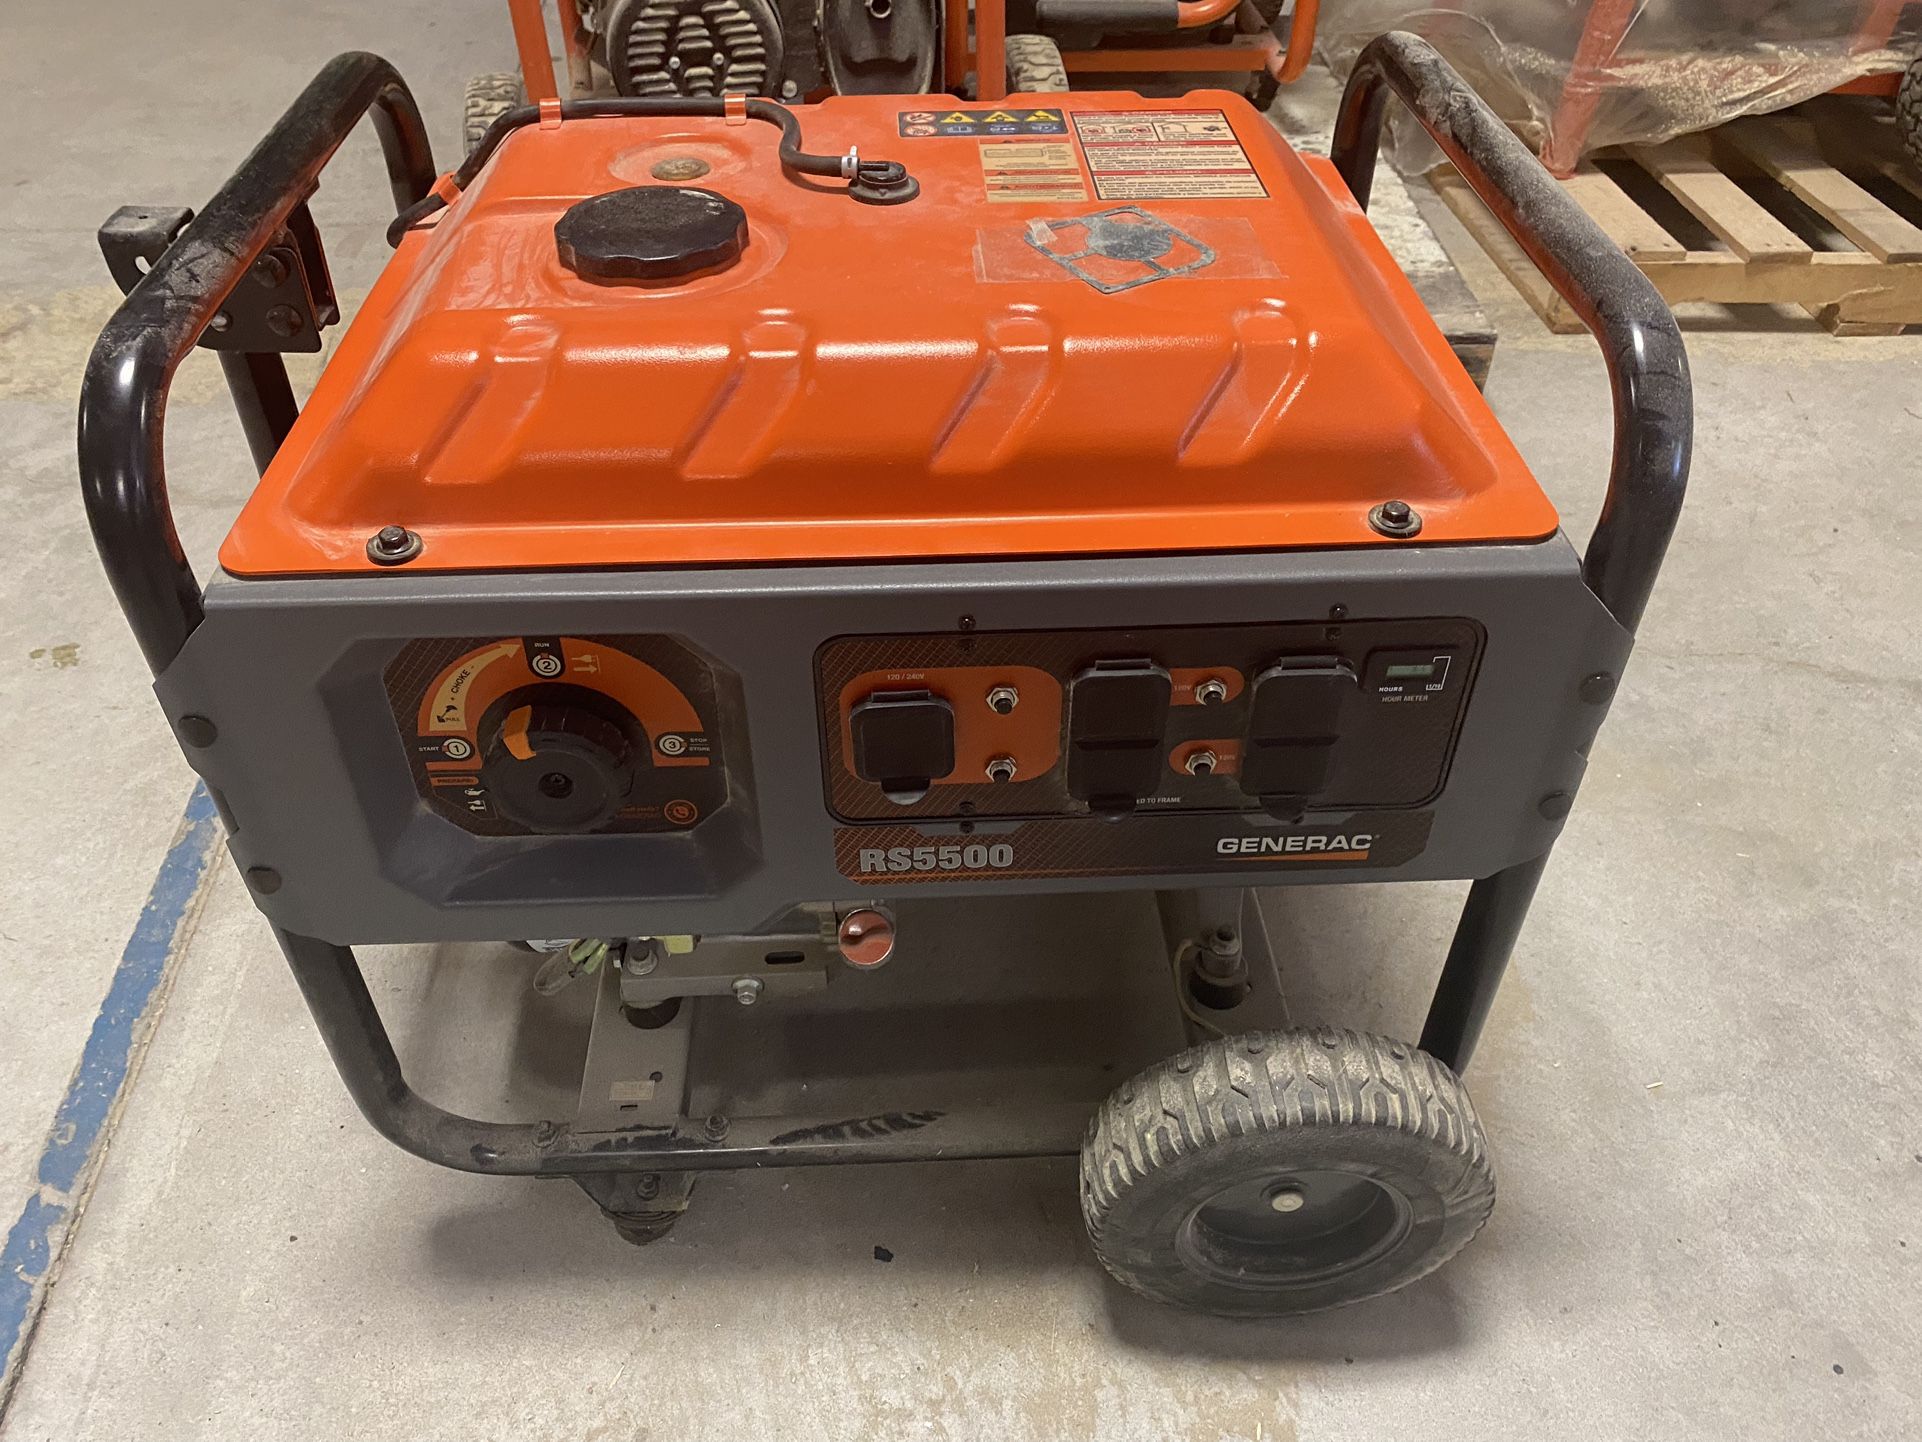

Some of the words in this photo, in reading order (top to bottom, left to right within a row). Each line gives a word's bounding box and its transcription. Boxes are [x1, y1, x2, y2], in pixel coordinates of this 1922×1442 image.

[542, 661, 552, 669] 2
[450, 669, 471, 694] CHOKE
[887, 673, 900, 681] 120
[1381, 695, 1402, 703] HOUR
[1403, 694, 1429, 702] METER
[668, 740, 676, 749] 3
[1216, 834, 1372, 854] GENERAC
[859, 843, 1014, 872] RS5500
